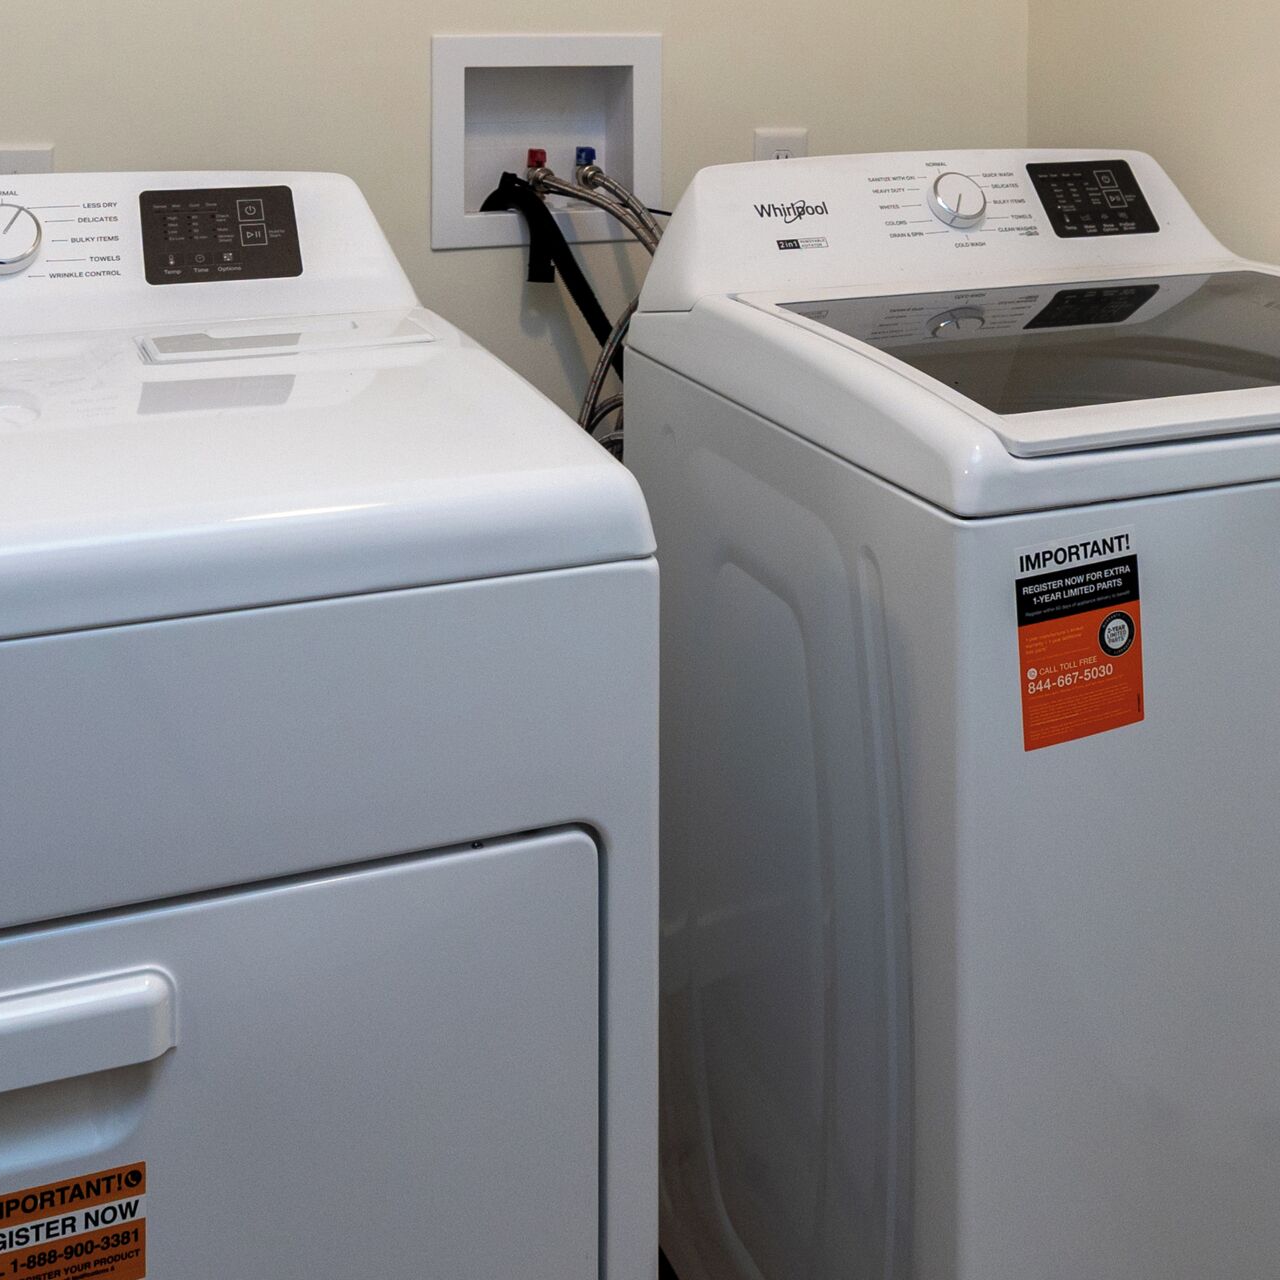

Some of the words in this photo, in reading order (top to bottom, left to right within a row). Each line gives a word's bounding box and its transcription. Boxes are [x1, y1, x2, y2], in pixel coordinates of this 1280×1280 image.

[77, 215, 119, 223] DELICATES
[753, 200, 829, 224] Whirlpool
[779, 241, 798, 249] 2in1
[1019, 533, 1130, 572] IMPORTANT!
[1022, 579, 1064, 596] REGISTER
[1064, 574, 1085, 587] NOW
[1086, 571, 1103, 582] FOR
[1104, 565, 1131, 578] EXTRA
[1033, 591, 1062, 605] 1-YEAR
[1063, 584, 1095, 598] LIMITED
[1097, 578, 1123, 591] PARTS
[1107, 624, 1126, 634] 2-YEAR
[1027, 663, 1114, 694] 844-667-5030
[1039, 666, 1058, 676] CALL
[1059, 661, 1078, 671] TOLL
[1079, 655, 1098, 666] FREE
[84, 1200, 140, 1230] NOW
[10, 1228, 140, 1273] 1-888-900-3381
[63, 1261, 92, 1274] YOUR
[93, 1248, 141, 1268] PRODUCT
